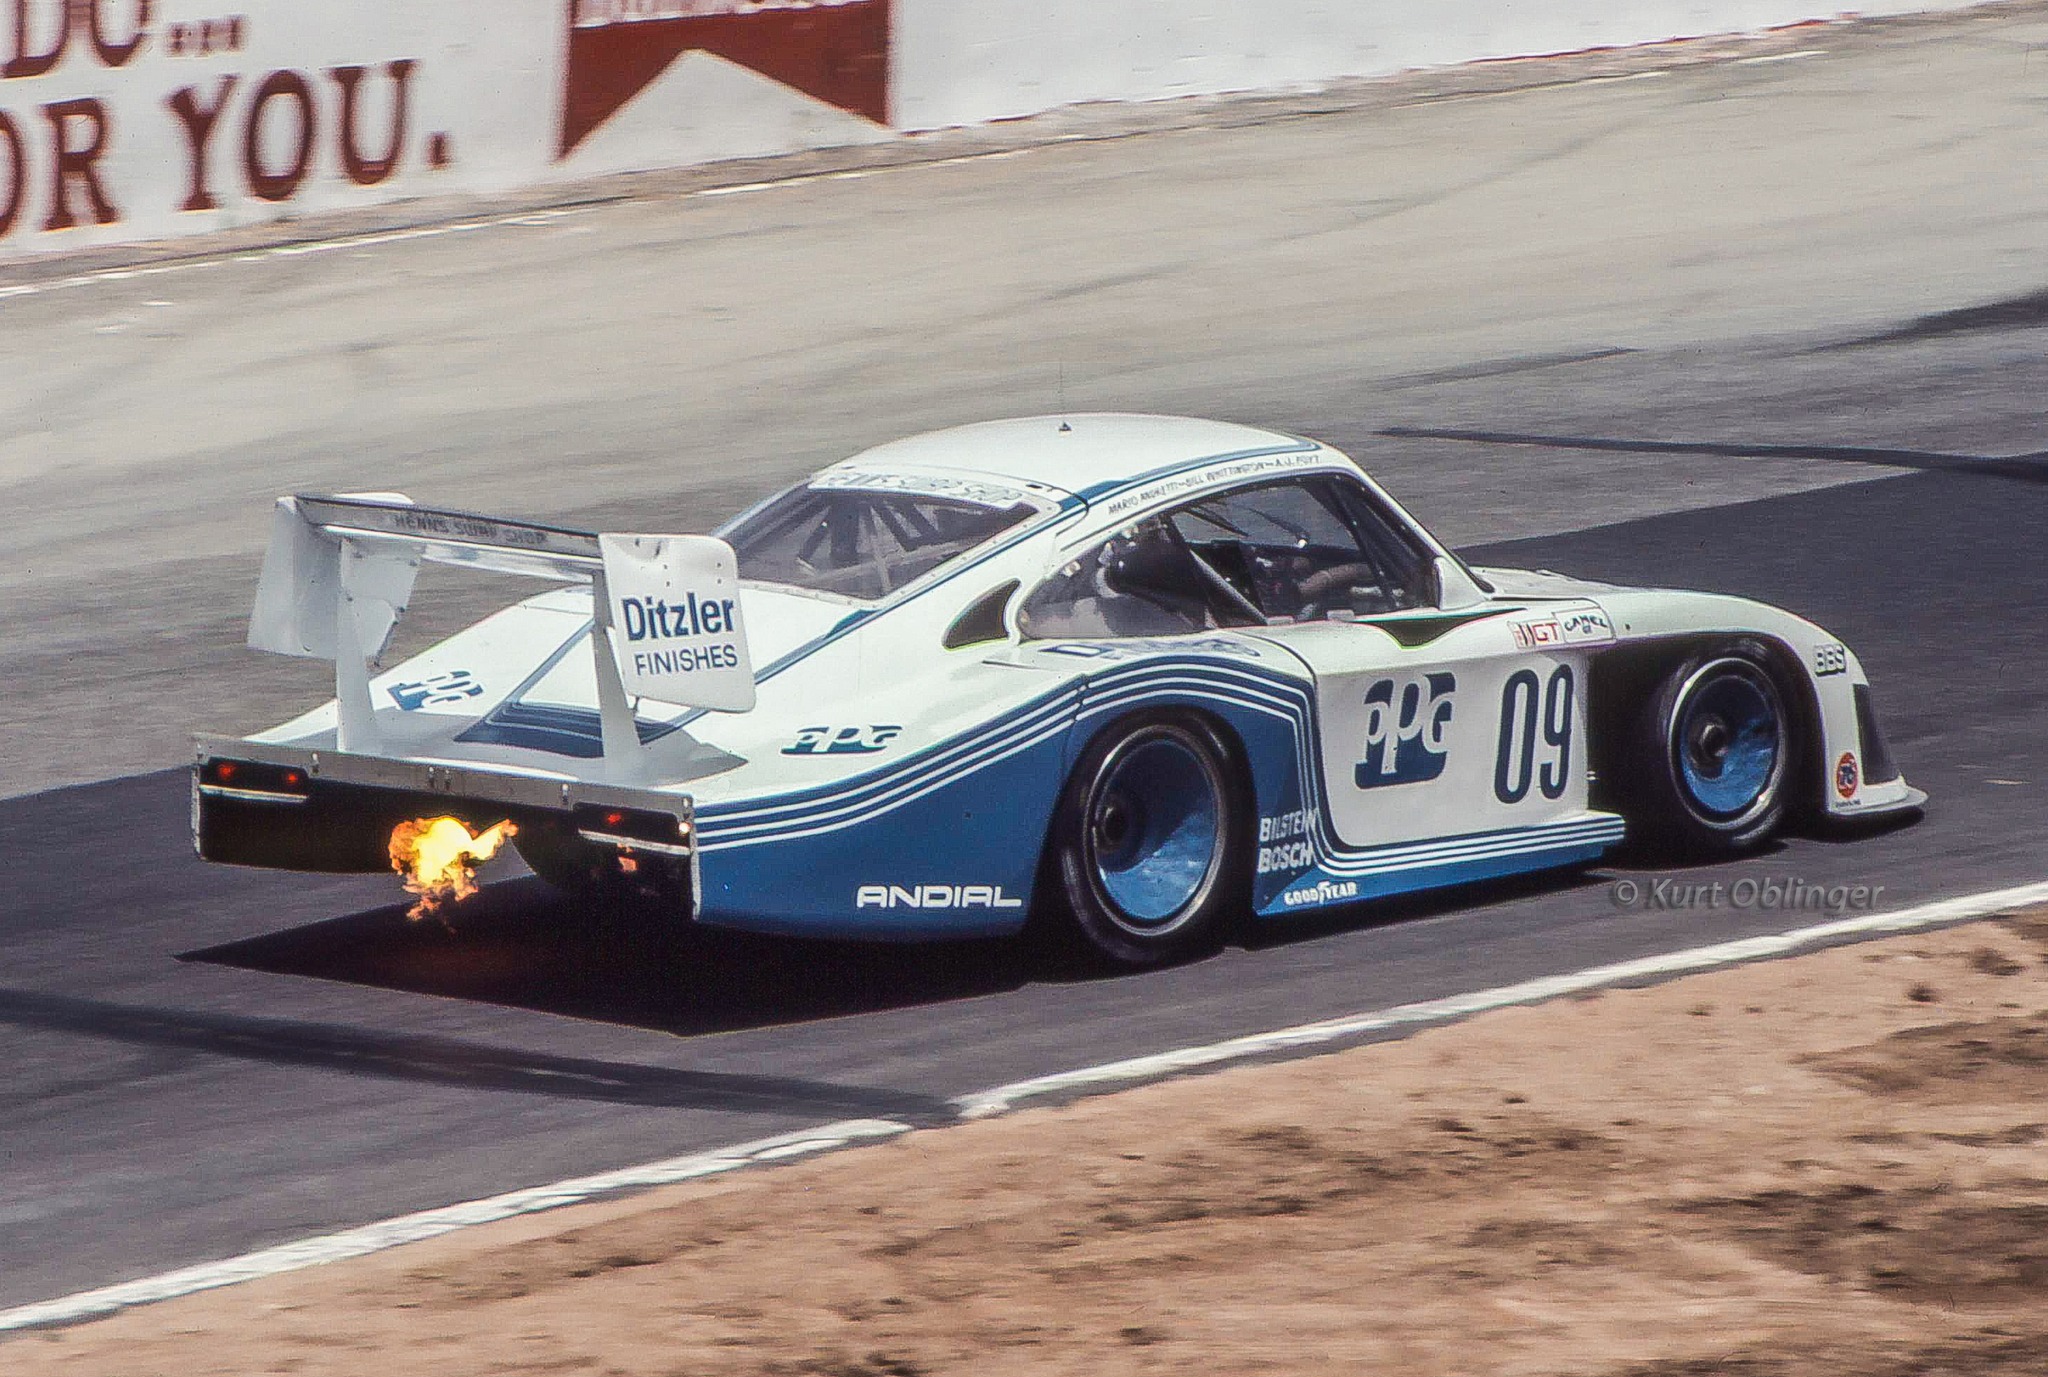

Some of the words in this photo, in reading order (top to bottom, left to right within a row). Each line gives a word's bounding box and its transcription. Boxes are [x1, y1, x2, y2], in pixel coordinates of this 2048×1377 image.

[165, 60, 450, 210] YOU.
[622, 592, 734, 641] Ditzler
[634, 644, 738, 676] FINISHES
[1814, 644, 1847, 677] BBS
[1494, 663, 1574, 804] 09
[1258, 841, 1314, 873] BOSCH
[857, 885, 1022, 908] ANDIAL
